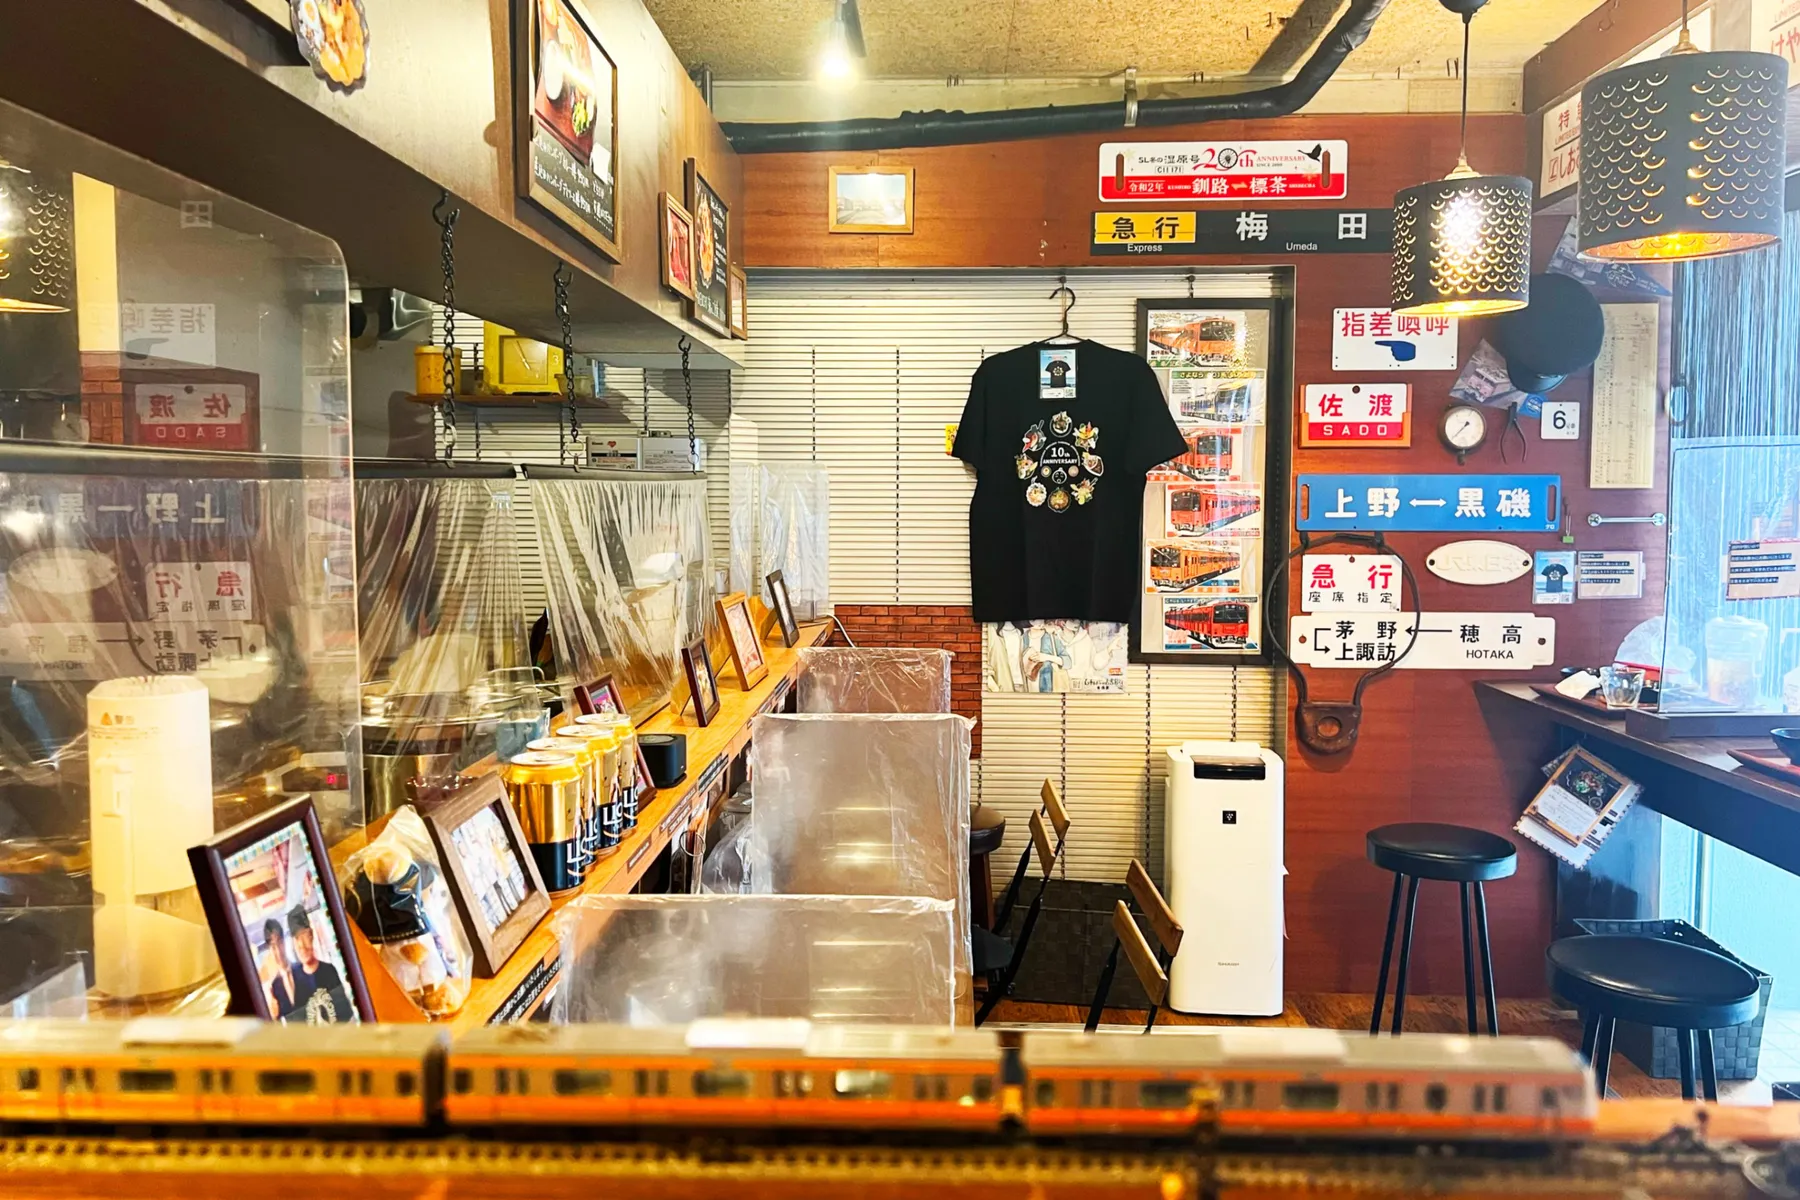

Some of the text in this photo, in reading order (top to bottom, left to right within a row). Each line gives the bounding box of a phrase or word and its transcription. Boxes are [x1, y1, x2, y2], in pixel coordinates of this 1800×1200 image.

[1129, 182, 1164, 193] 令和2年
[1192, 177, 1229, 195] 釧路
[1249, 176, 1287, 195] 標茶
[1112, 216, 1179, 239] 急行
[1127, 241, 1318, 254] Express Umeda
[1319, 393, 1393, 417] 佐渡
[1553, 410, 1566, 429] 6
[1323, 424, 1388, 436] SADO
[1051, 447, 1071, 458] 10th
[1324, 488, 1531, 518] 上野 黒磯
[1310, 564, 1393, 590] 急行
[1308, 591, 1393, 604] 座席指定
[1335, 620, 1523, 644] 茅野 穂高
[1335, 642, 1515, 662] 上諏訪 HOTAKA
